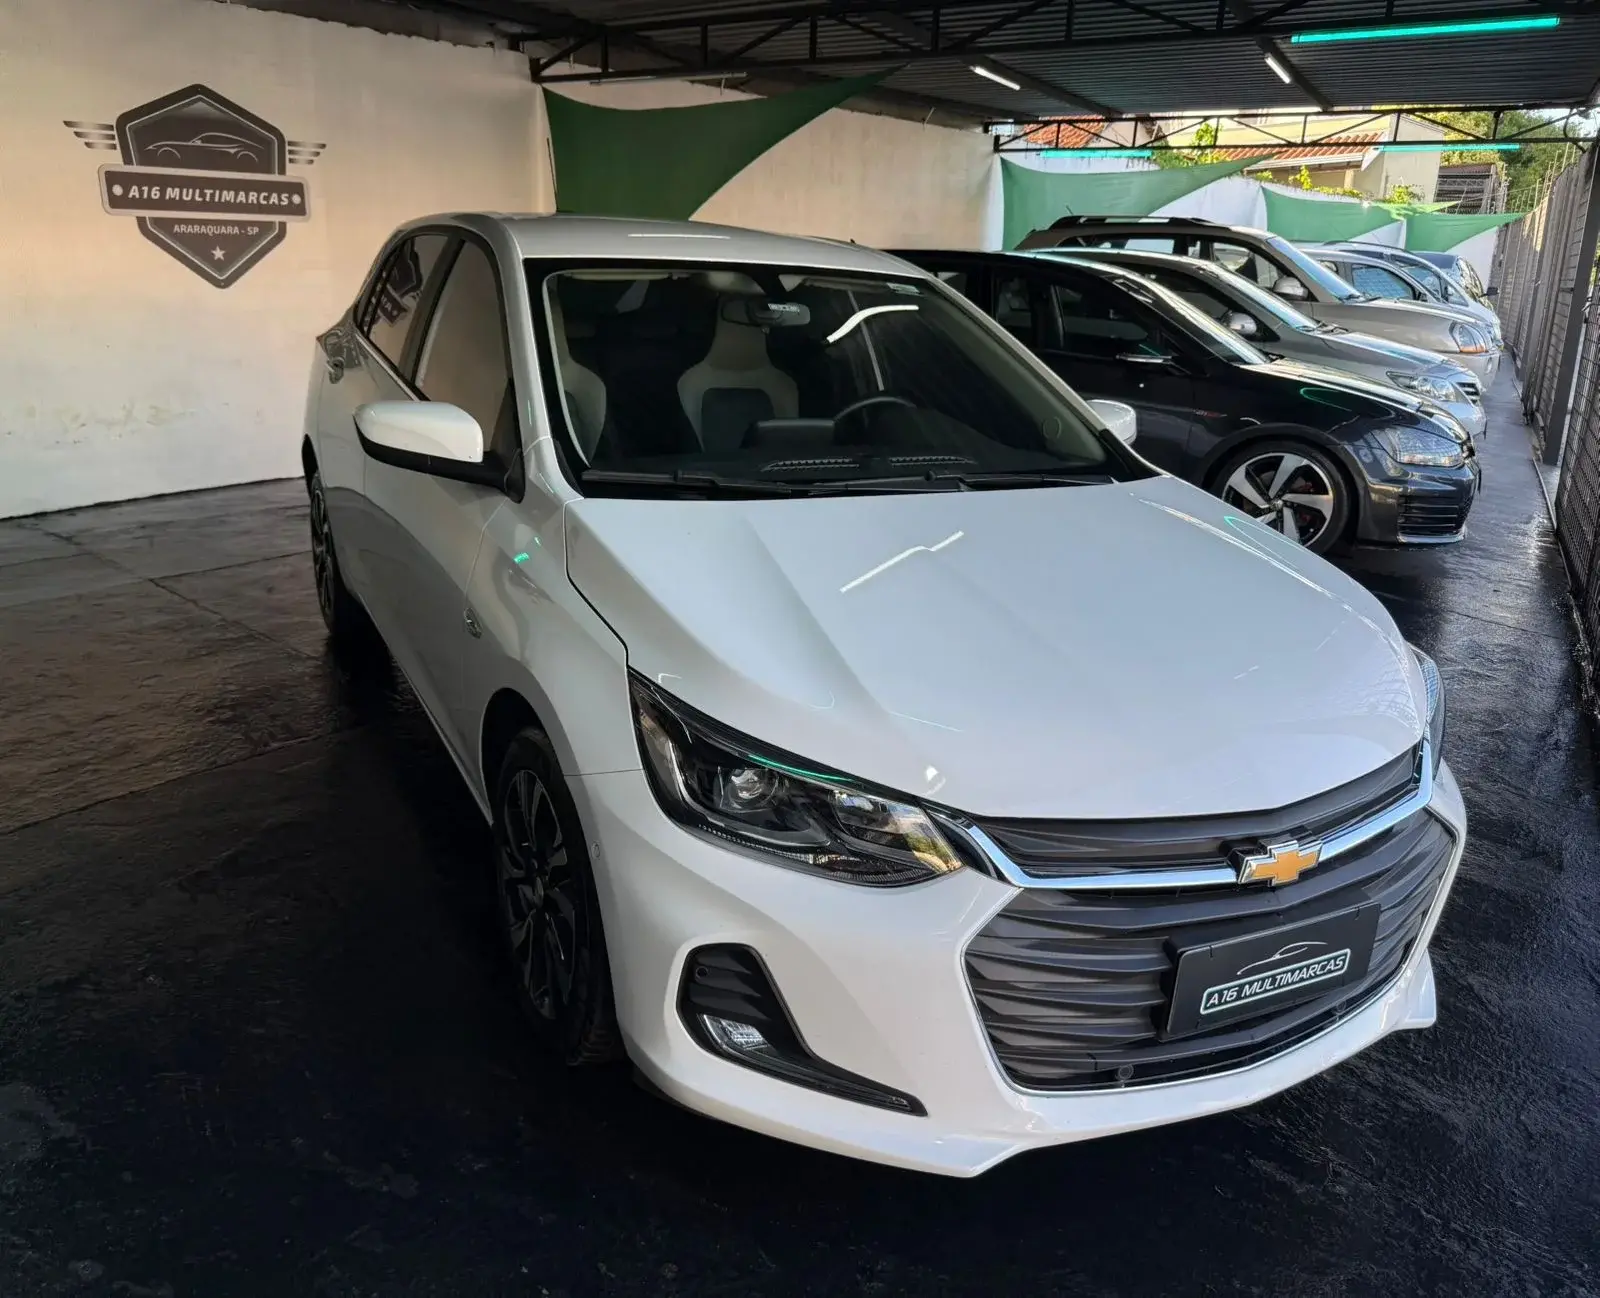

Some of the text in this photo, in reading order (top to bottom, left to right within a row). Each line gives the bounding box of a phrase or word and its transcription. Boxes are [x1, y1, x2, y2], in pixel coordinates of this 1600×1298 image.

[128, 186, 290, 206] A16 MULTIMARCAS
[173, 224, 240, 237] ARARAQUARA
[247, 226, 260, 236] SP
[1207, 955, 1345, 1006] A16 MULTIMARCAS
